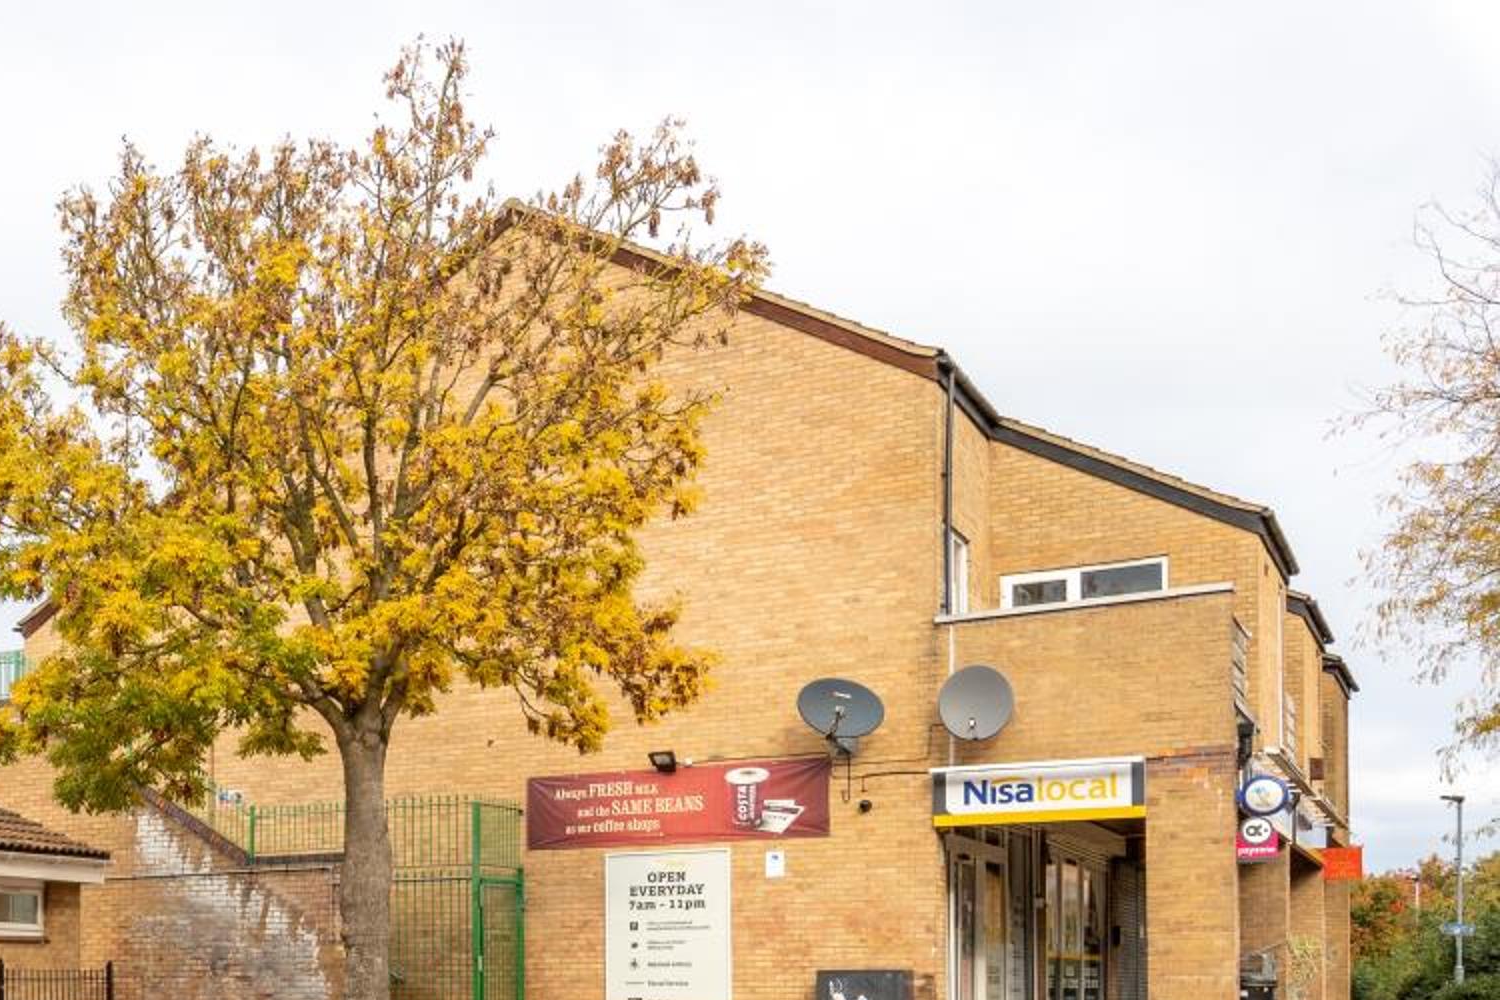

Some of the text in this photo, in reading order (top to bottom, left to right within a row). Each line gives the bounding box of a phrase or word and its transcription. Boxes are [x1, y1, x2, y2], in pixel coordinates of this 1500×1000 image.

[589, 781, 633, 797] FRESH
[595, 805, 611, 817] the
[611, 799, 653, 815] SAME
[655, 795, 705, 813] BEANS
[593, 819, 625, 833] coffee
[627, 818, 661, 833] shops
[647, 871, 686, 883] OPEN
[629, 883, 705, 897] EVERYDAY
[628, 900, 657, 911] 7am
[669, 899, 706, 911] 11pm
